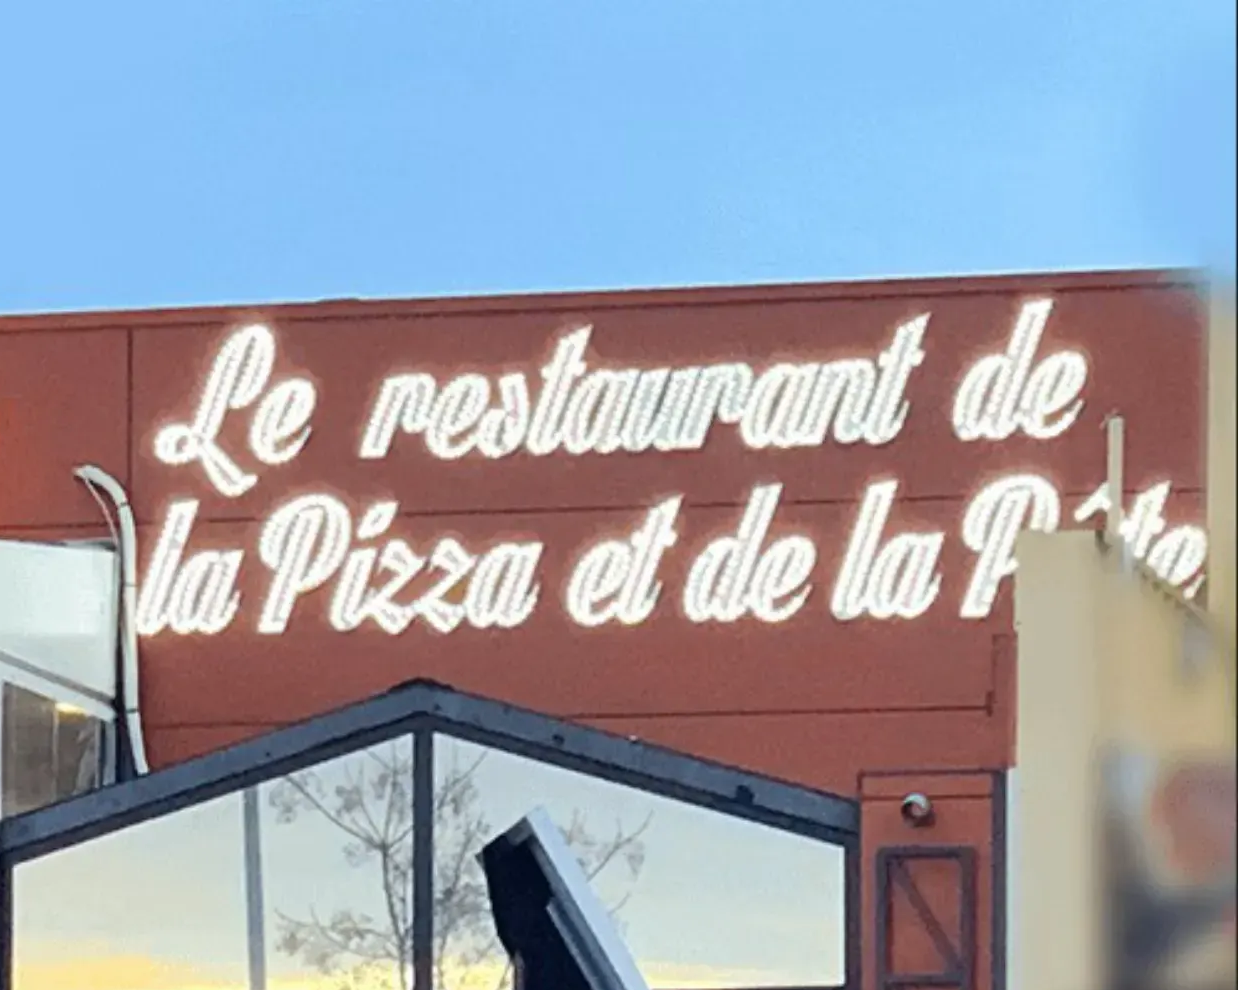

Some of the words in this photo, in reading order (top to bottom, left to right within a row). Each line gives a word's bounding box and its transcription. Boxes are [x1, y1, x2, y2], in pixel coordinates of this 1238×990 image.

[153, 323, 317, 496] Le
[360, 312, 931, 460] restaurant
[952, 298, 1088, 441] de
[132, 500, 244, 635] la
[257, 493, 544, 634] Pizza
[566, 494, 684, 626] et
[683, 482, 817, 622] de
[830, 480, 945, 620] la
